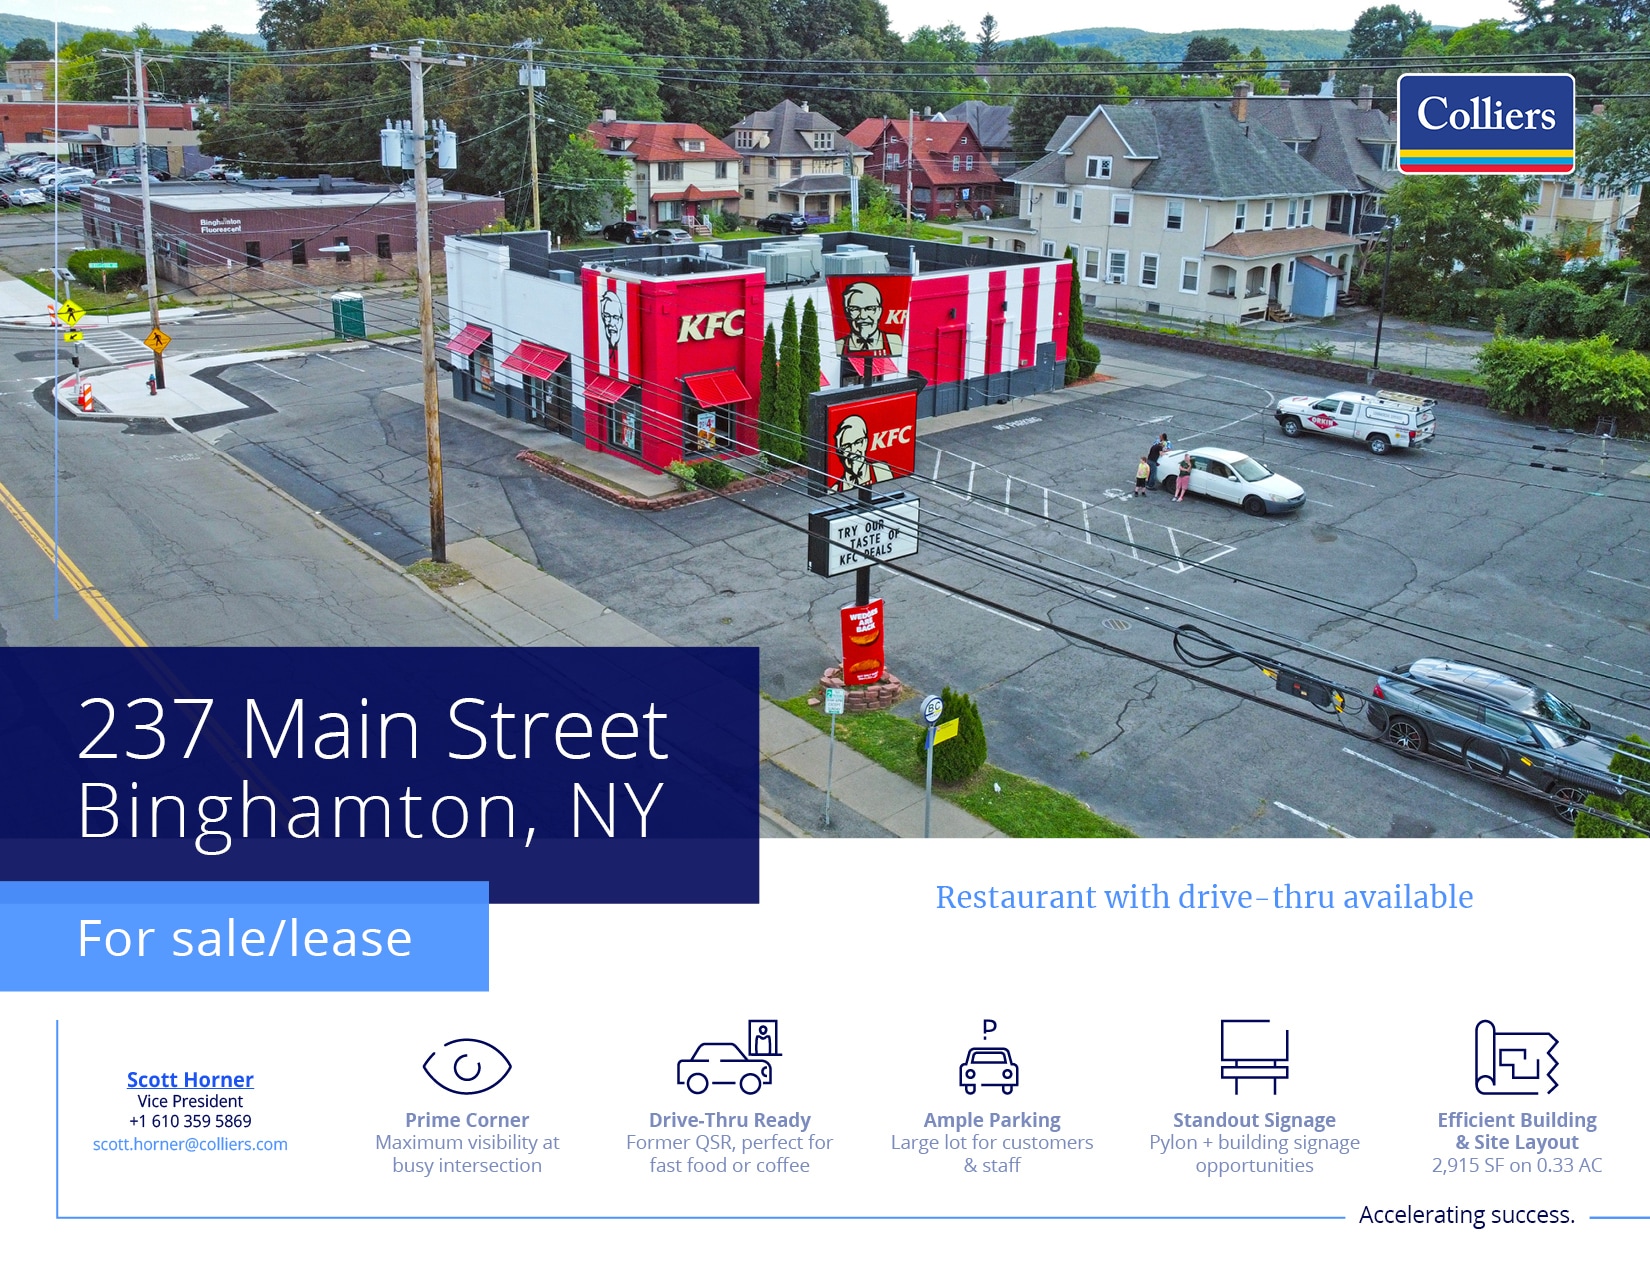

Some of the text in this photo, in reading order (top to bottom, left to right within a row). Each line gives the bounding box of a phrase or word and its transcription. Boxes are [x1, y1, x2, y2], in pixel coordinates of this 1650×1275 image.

[677, 309, 745, 343] KFC
[1311, 416, 1334, 426] ORKIN
[870, 425, 912, 452] KFC
[838, 519, 884, 539] TRY OUR
[850, 527, 900, 549] TASTE OF
[840, 543, 892, 566] KFC DEALS
[856, 622, 876, 633] BACK
